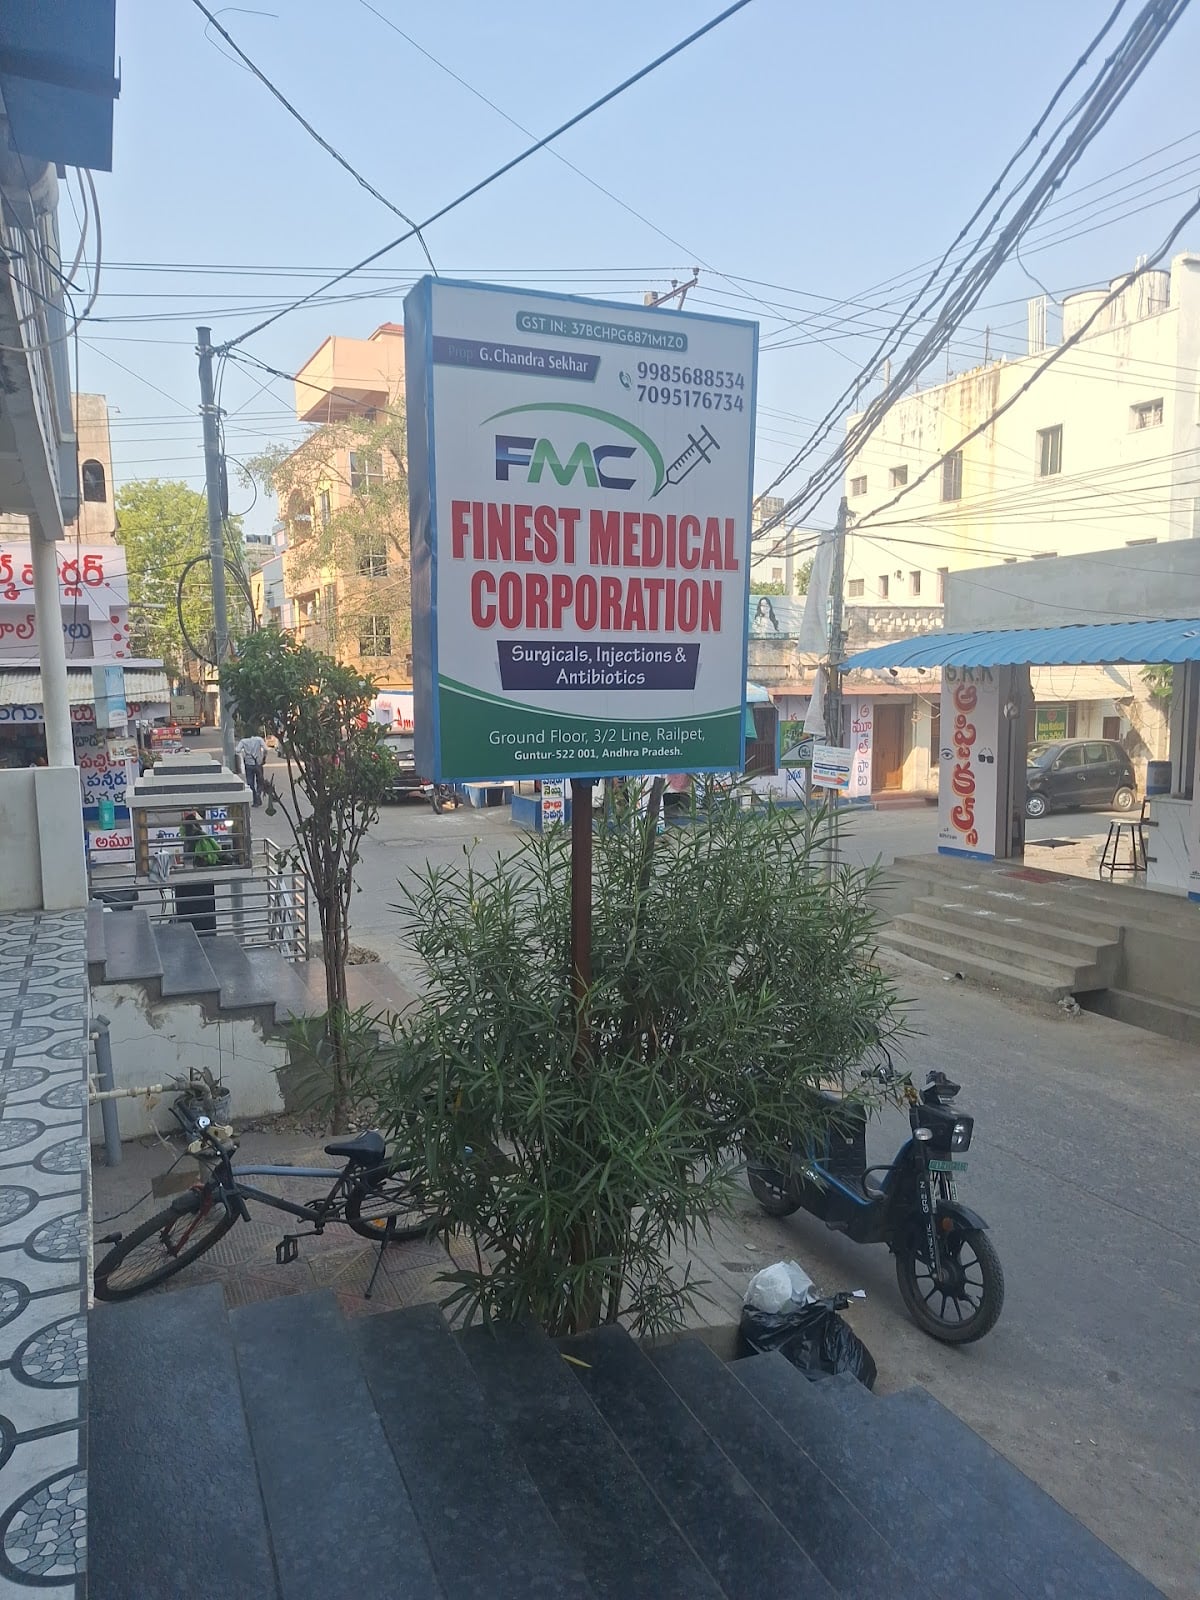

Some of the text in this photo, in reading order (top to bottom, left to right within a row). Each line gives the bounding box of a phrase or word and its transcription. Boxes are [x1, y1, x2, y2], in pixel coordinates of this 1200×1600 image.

[521, 316, 546, 330] GST
[550, 320, 567, 333] IN:
[548, 355, 589, 373] Sekhar
[637, 361, 744, 390] 9985688534
[637, 384, 744, 412] 7095176734
[495, 434, 637, 490] FMC
[451, 500, 739, 572] FINEST MEDICAL
[470, 569, 722, 633] CORPORATION
[511, 645, 687, 667] Surgicals, Injections &
[556, 668, 646, 684] Antibiotics
[489, 727, 705, 745] Ground Floor, 3/2 Line, Railpet,
[514, 746, 684, 761] Guntur-522 001, Andhra Pradesh.
